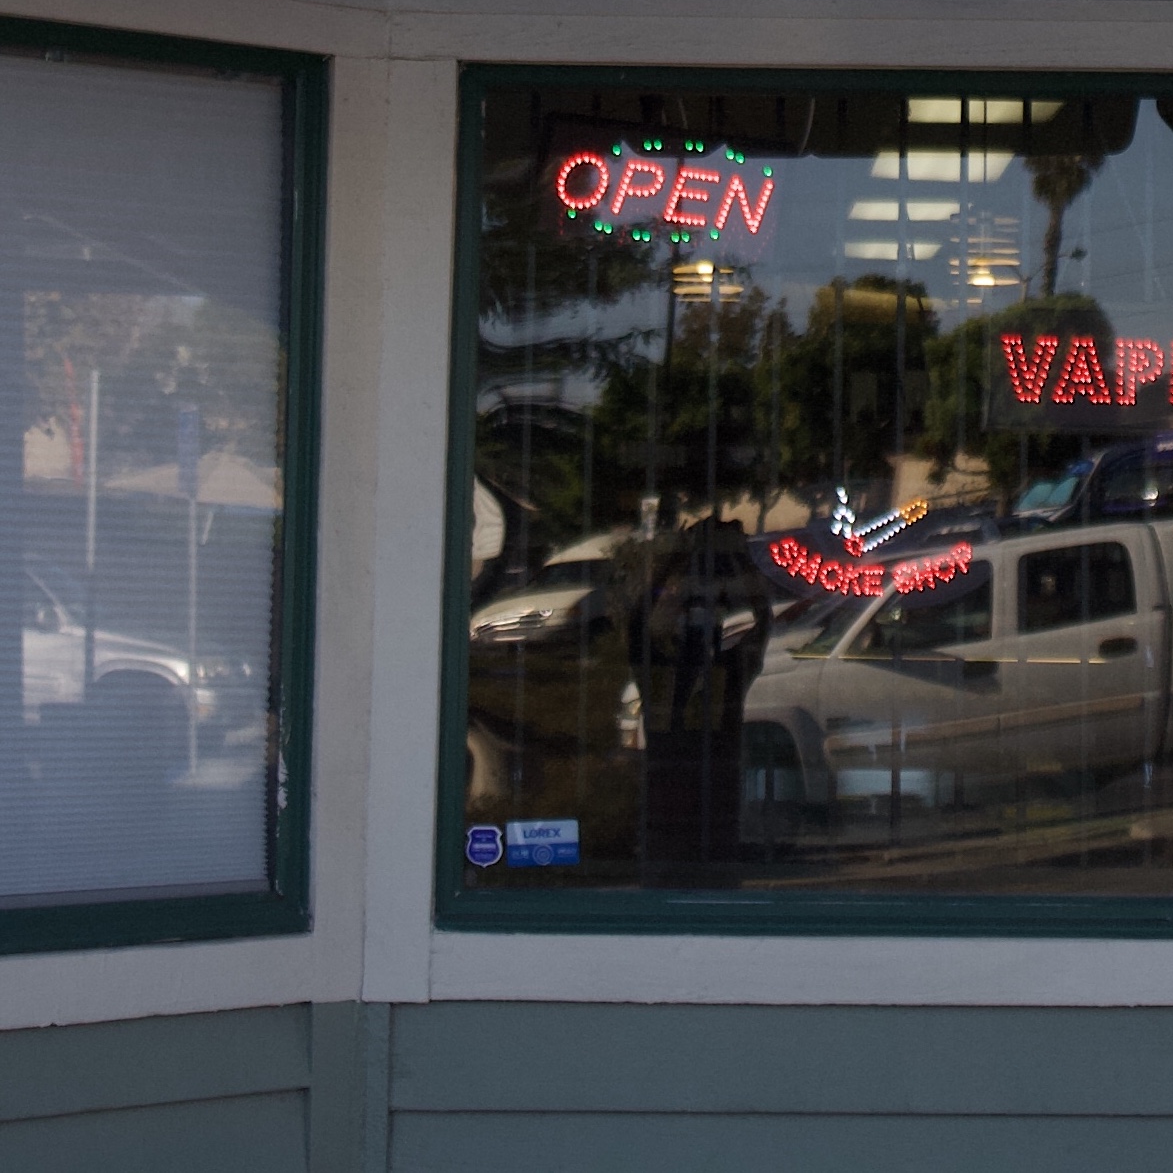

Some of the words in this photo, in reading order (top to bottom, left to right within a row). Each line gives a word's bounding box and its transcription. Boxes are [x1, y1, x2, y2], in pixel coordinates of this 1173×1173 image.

[556, 151, 774, 235] OPEN
[769, 536, 885, 597] SMOKE
[892, 540, 973, 594] SHOP
[523, 827, 562, 839] LOREX
